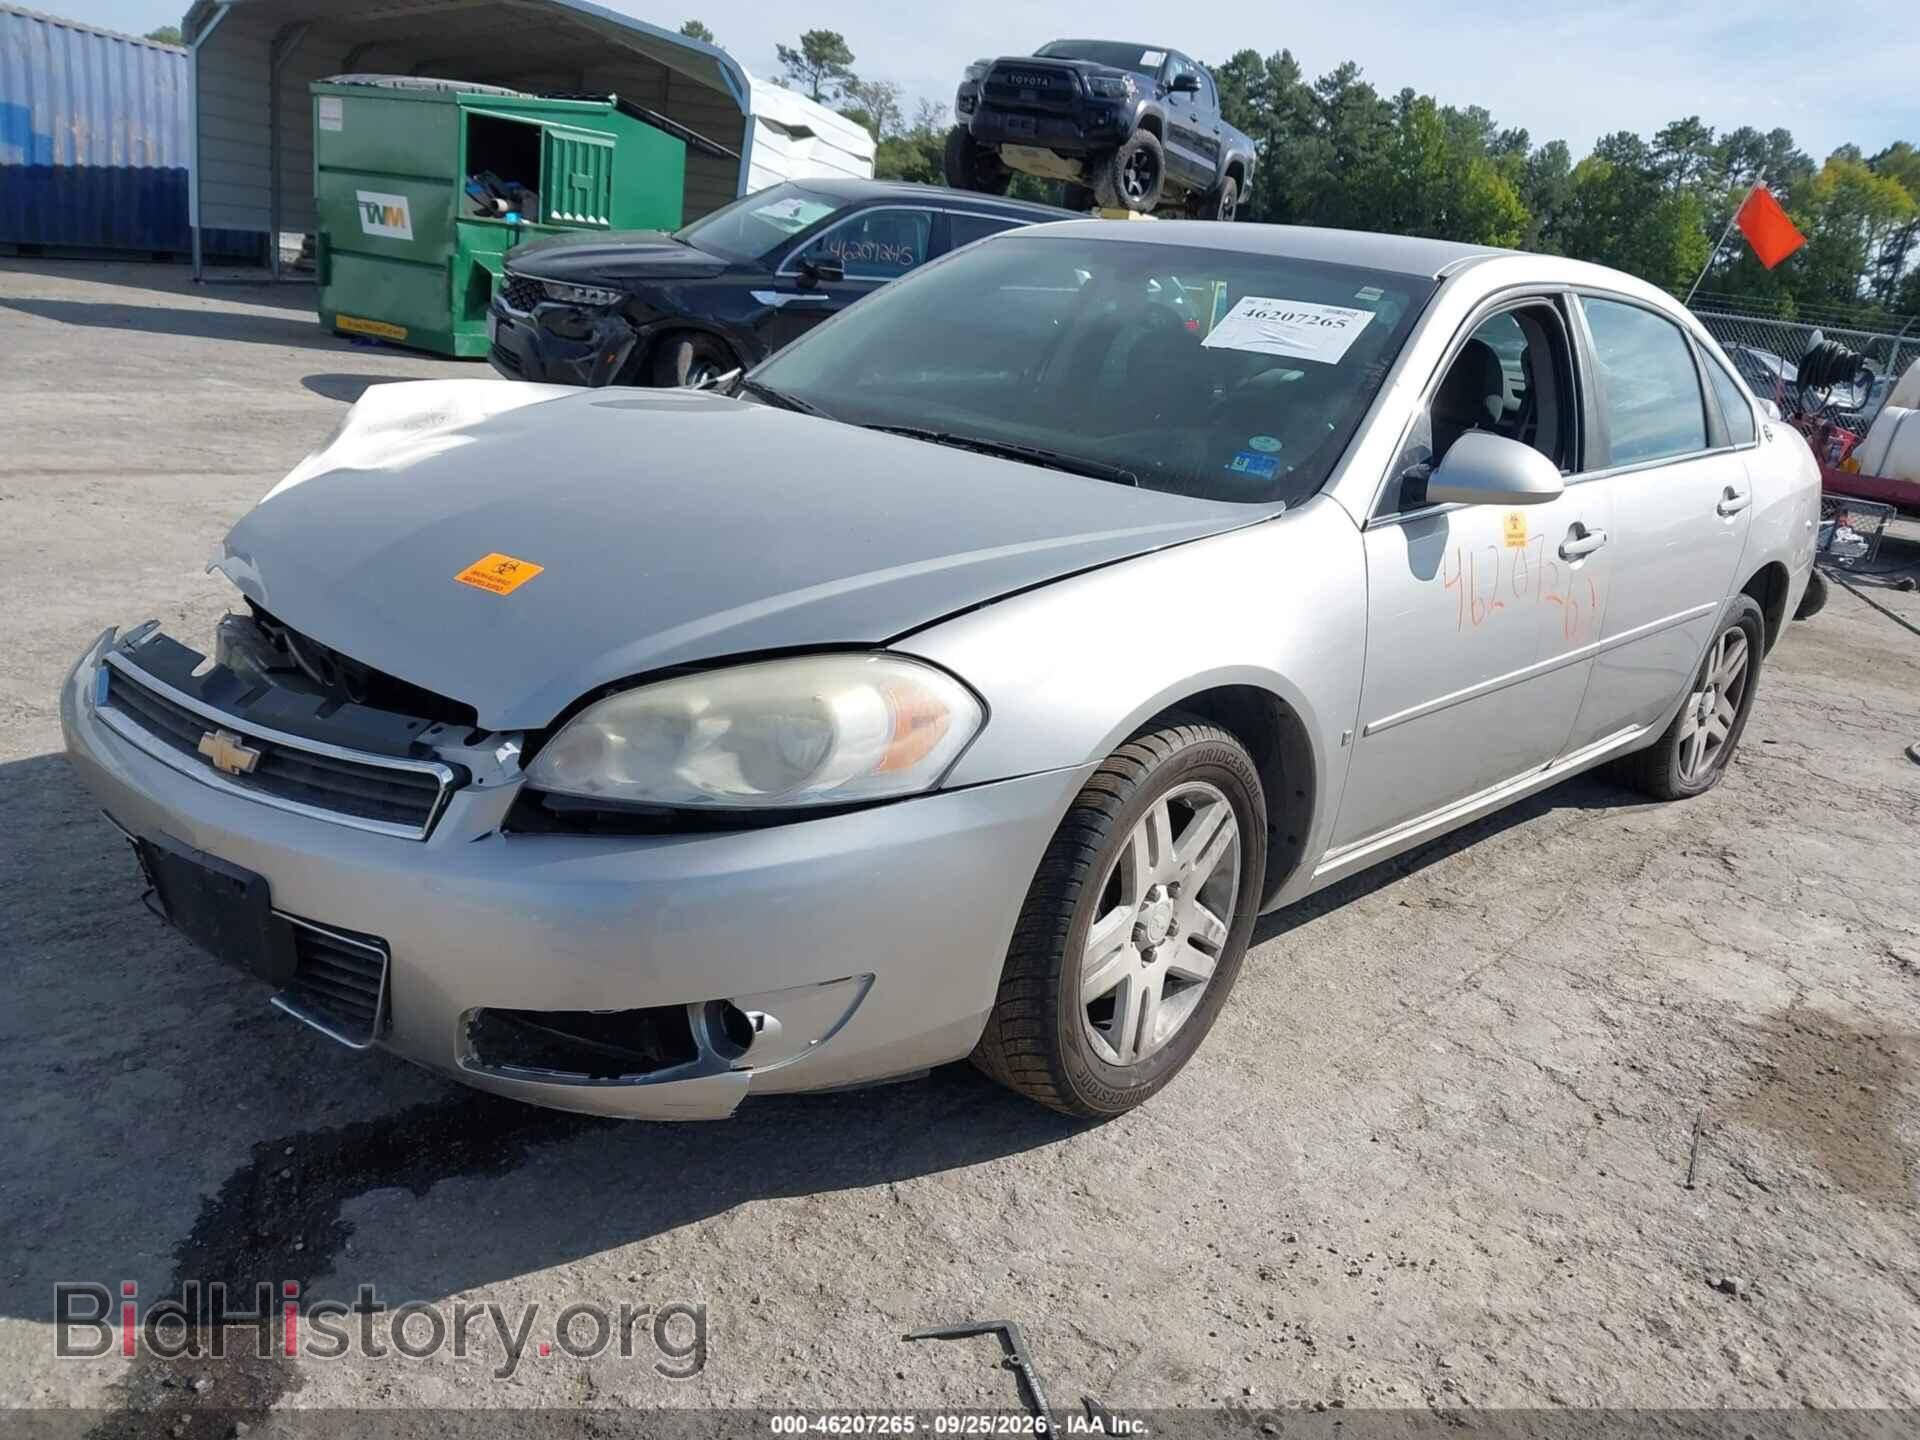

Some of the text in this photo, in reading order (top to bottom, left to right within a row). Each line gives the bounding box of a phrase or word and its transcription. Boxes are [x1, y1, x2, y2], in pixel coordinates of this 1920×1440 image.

[1010, 74, 1048, 87] TOYOTA
[364, 202, 406, 227] WM
[1242, 308, 1349, 329] 46207265
[1195, 748, 1260, 802] BRIDGESTONE
